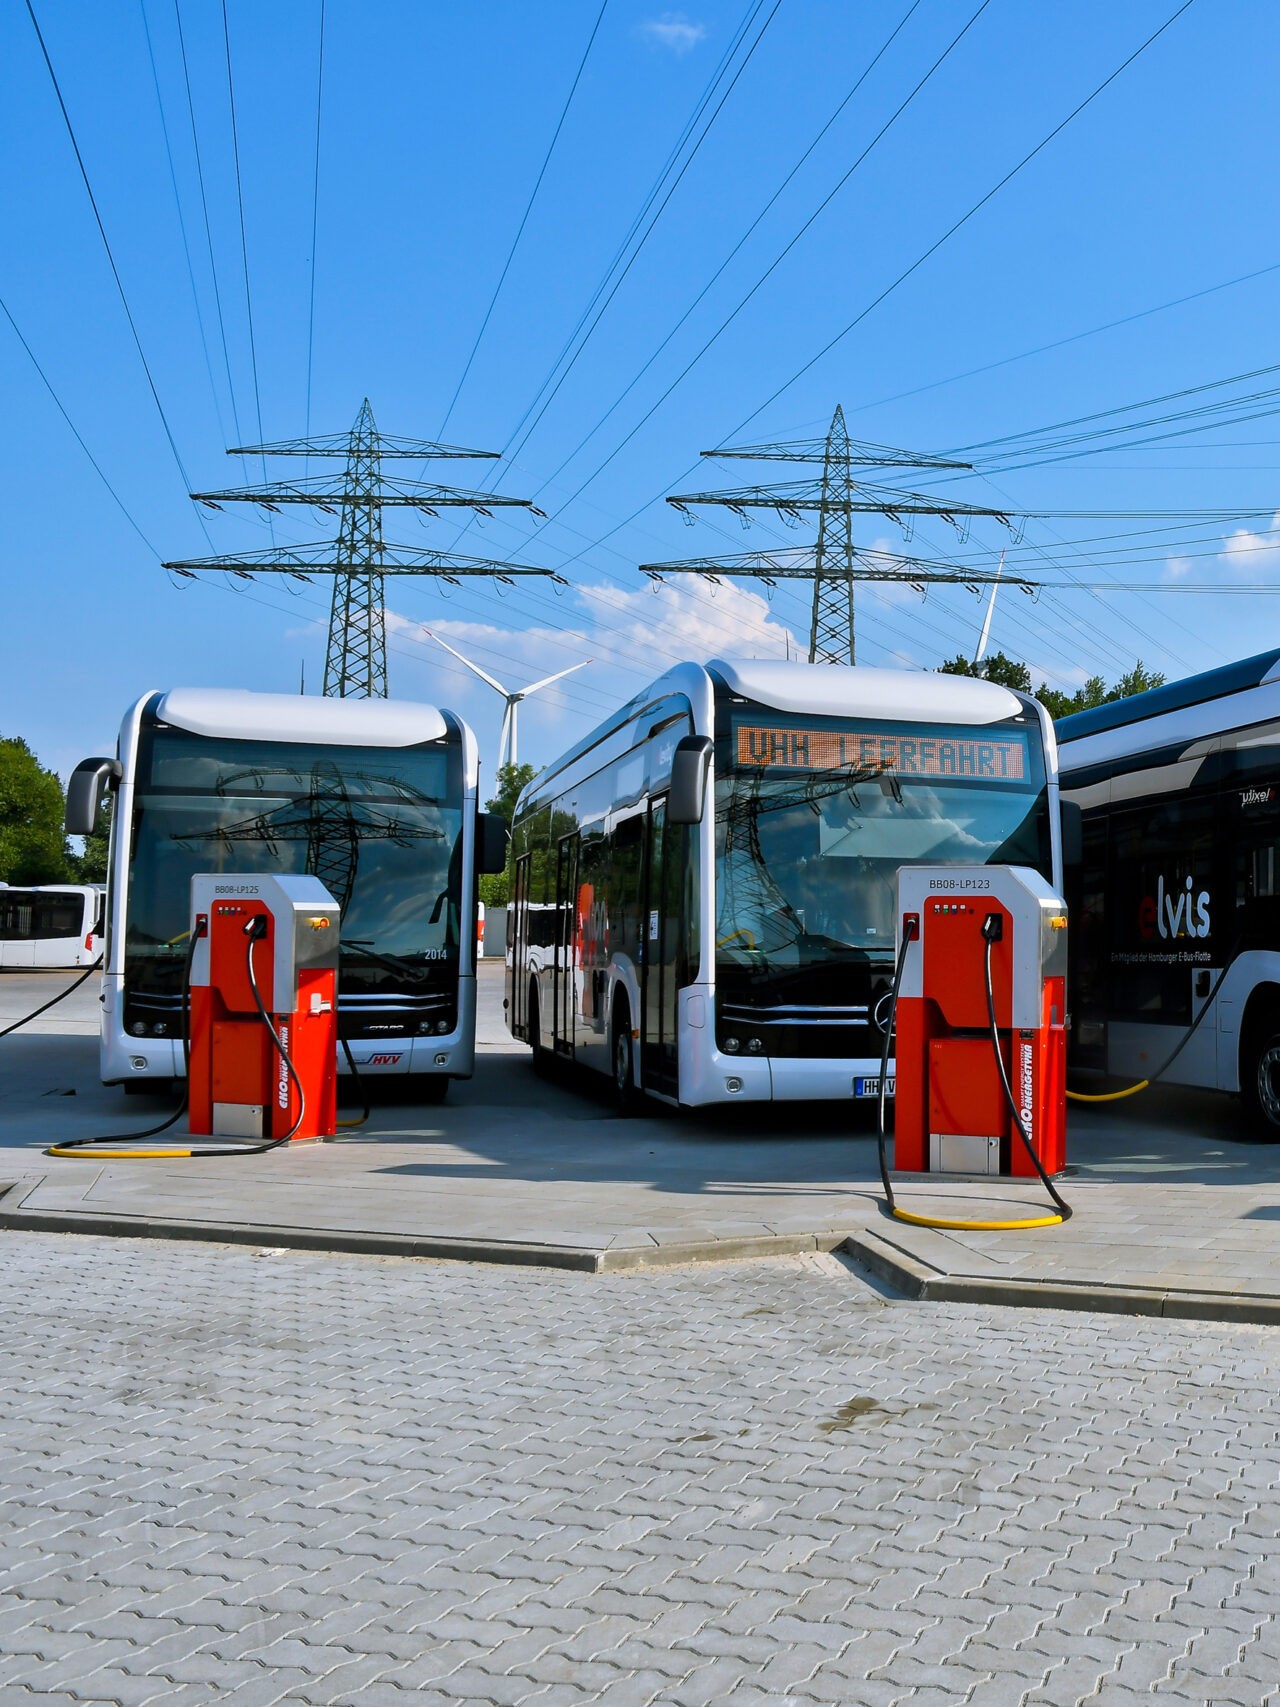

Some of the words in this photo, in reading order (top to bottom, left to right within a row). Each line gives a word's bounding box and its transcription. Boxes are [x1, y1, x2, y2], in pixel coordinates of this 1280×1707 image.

[750, 731, 809, 765] VHH
[839, 736, 1011, 775] LEERFAHRT
[215, 885, 259, 894] BB08-LP125
[929, 879, 990, 889] BB08-LP123
[1138, 874, 1211, 939] elvis
[424, 948, 448, 960] 2014
[1148, 952, 1178, 964] Hamburger
[372, 1055, 402, 1065] HVV
[864, 1080, 879, 1094] HH
[888, 1080, 896, 1094] V
